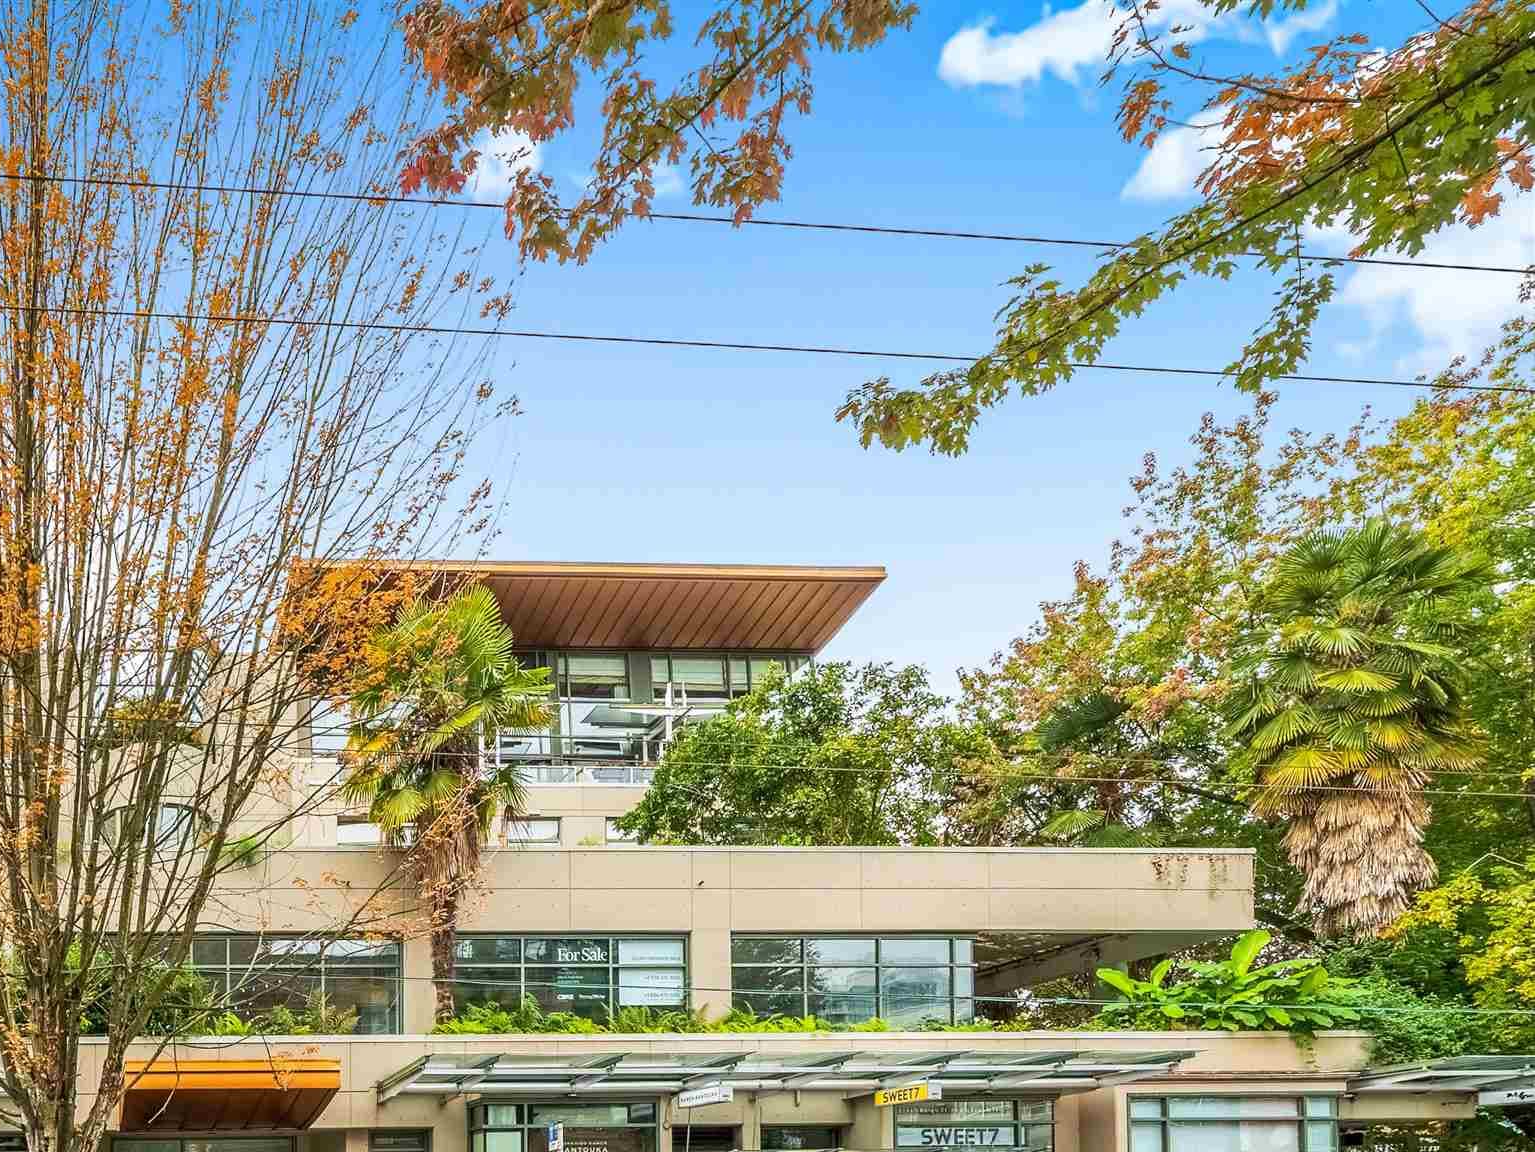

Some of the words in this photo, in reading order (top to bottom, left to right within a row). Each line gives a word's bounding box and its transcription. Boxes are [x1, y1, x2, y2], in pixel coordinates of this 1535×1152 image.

[557, 948, 580, 961] For
[581, 947, 608, 961] Sale
[882, 1087, 920, 1104] SWEET7
[920, 1128, 1000, 1146] SWEET7
